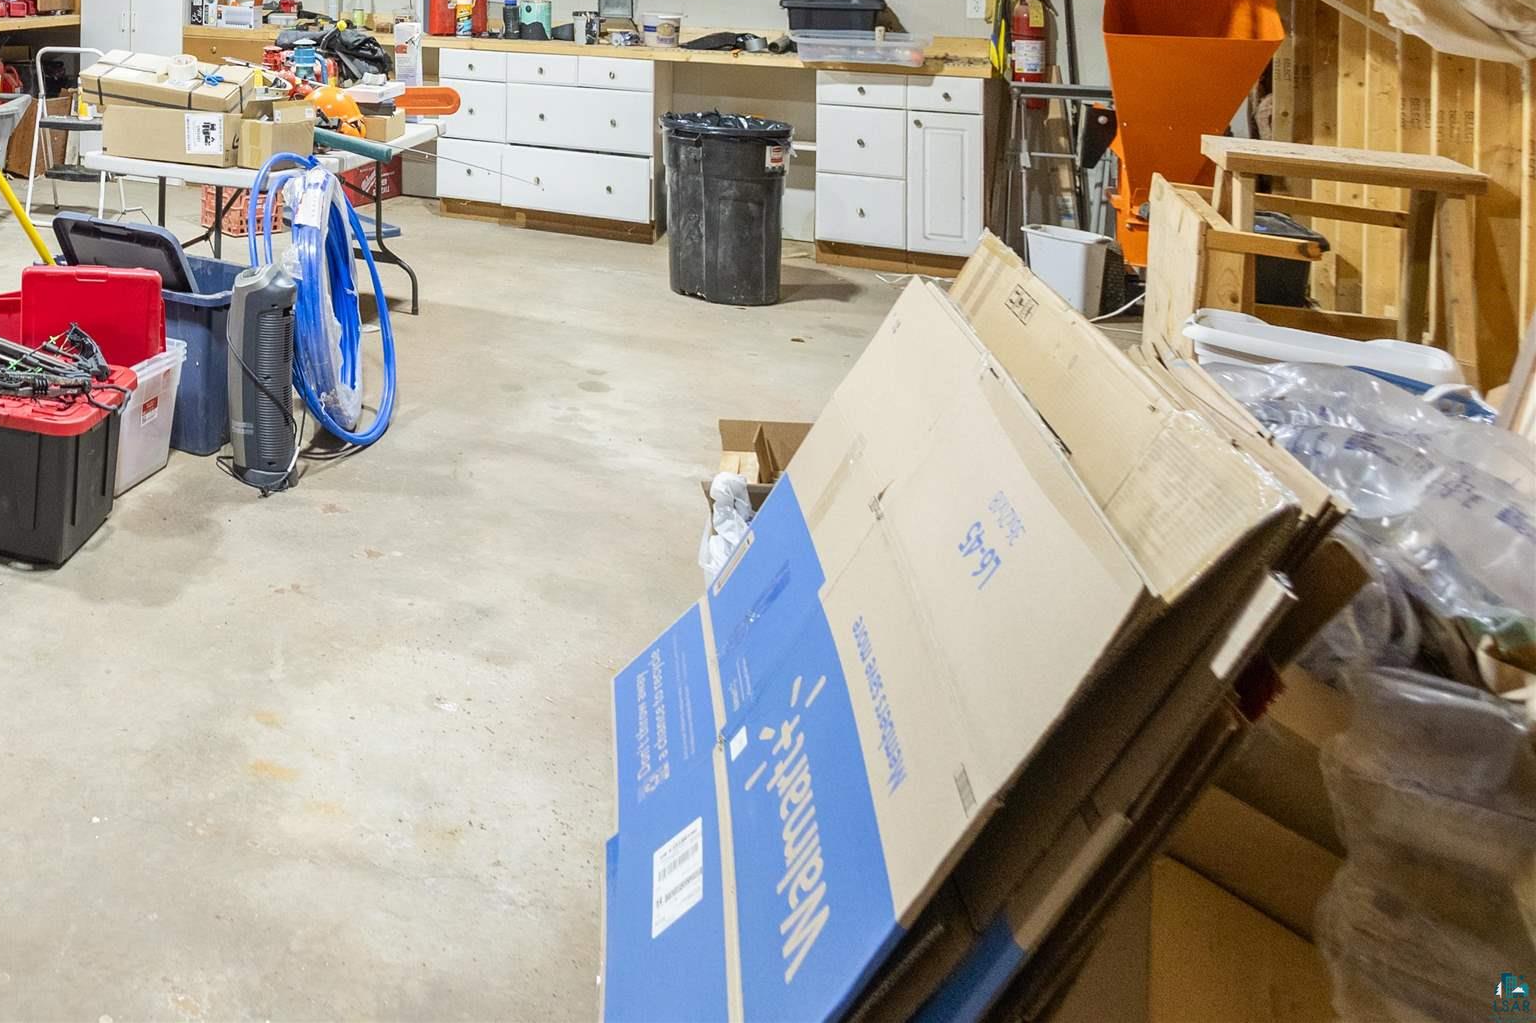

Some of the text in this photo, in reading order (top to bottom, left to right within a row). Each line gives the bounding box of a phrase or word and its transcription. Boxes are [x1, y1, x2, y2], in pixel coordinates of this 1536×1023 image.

[852, 616, 907, 796] Members save more
